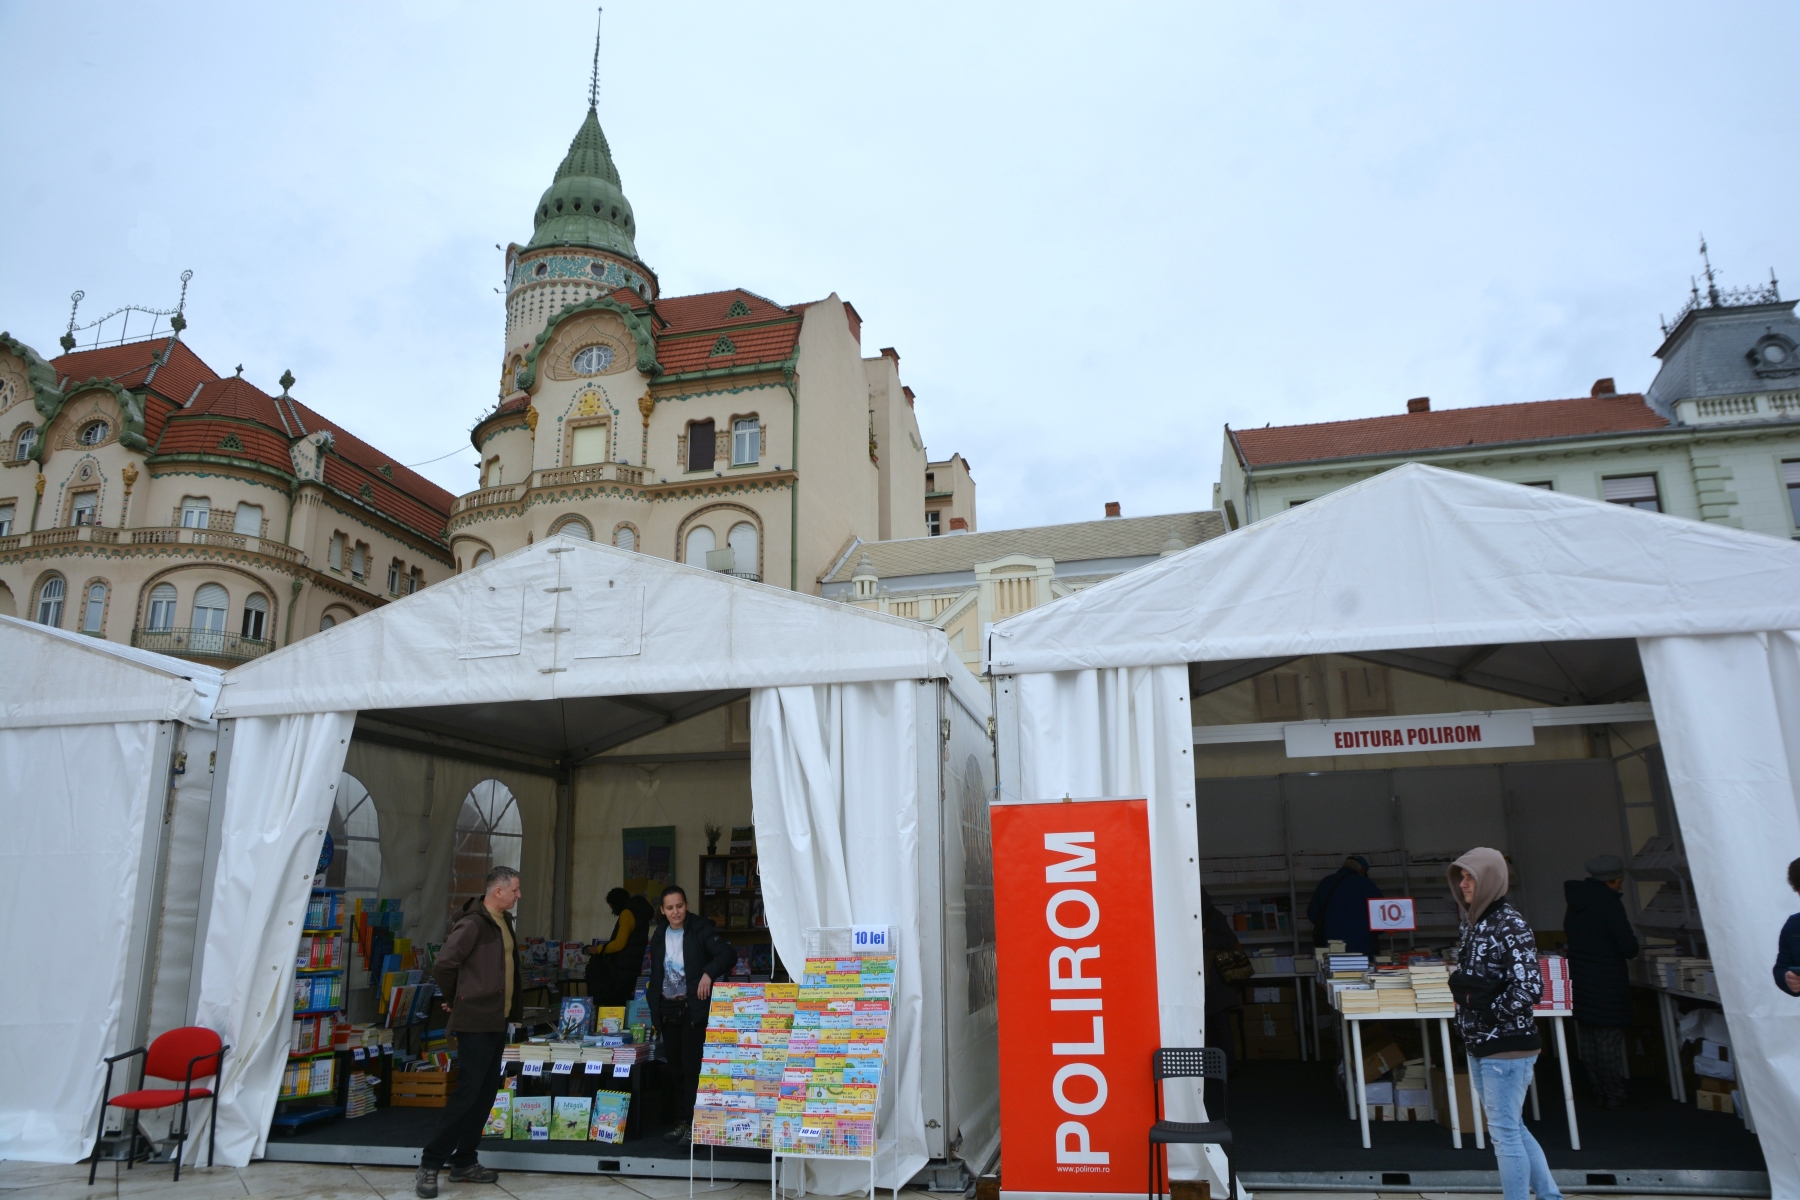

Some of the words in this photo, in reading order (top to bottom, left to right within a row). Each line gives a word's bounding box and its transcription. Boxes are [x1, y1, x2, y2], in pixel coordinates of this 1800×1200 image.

[1334, 729, 1404, 749] EDITURA
[1407, 725, 1482, 745] POLIROM
[1379, 903, 1402, 922] 10
[854, 931, 868, 945] 10
[869, 931, 885, 945] lei
[1044, 831, 1110, 1165] POLIROM
[524, 1064, 532, 1072] 10
[532, 1064, 541, 1072] lei
[562, 1063, 572, 1071] lei
[598, 1129, 605, 1138] 10
[605, 1131, 613, 1140] lei
[1056, 1165, 1110, 1174] www.polirom.ro
